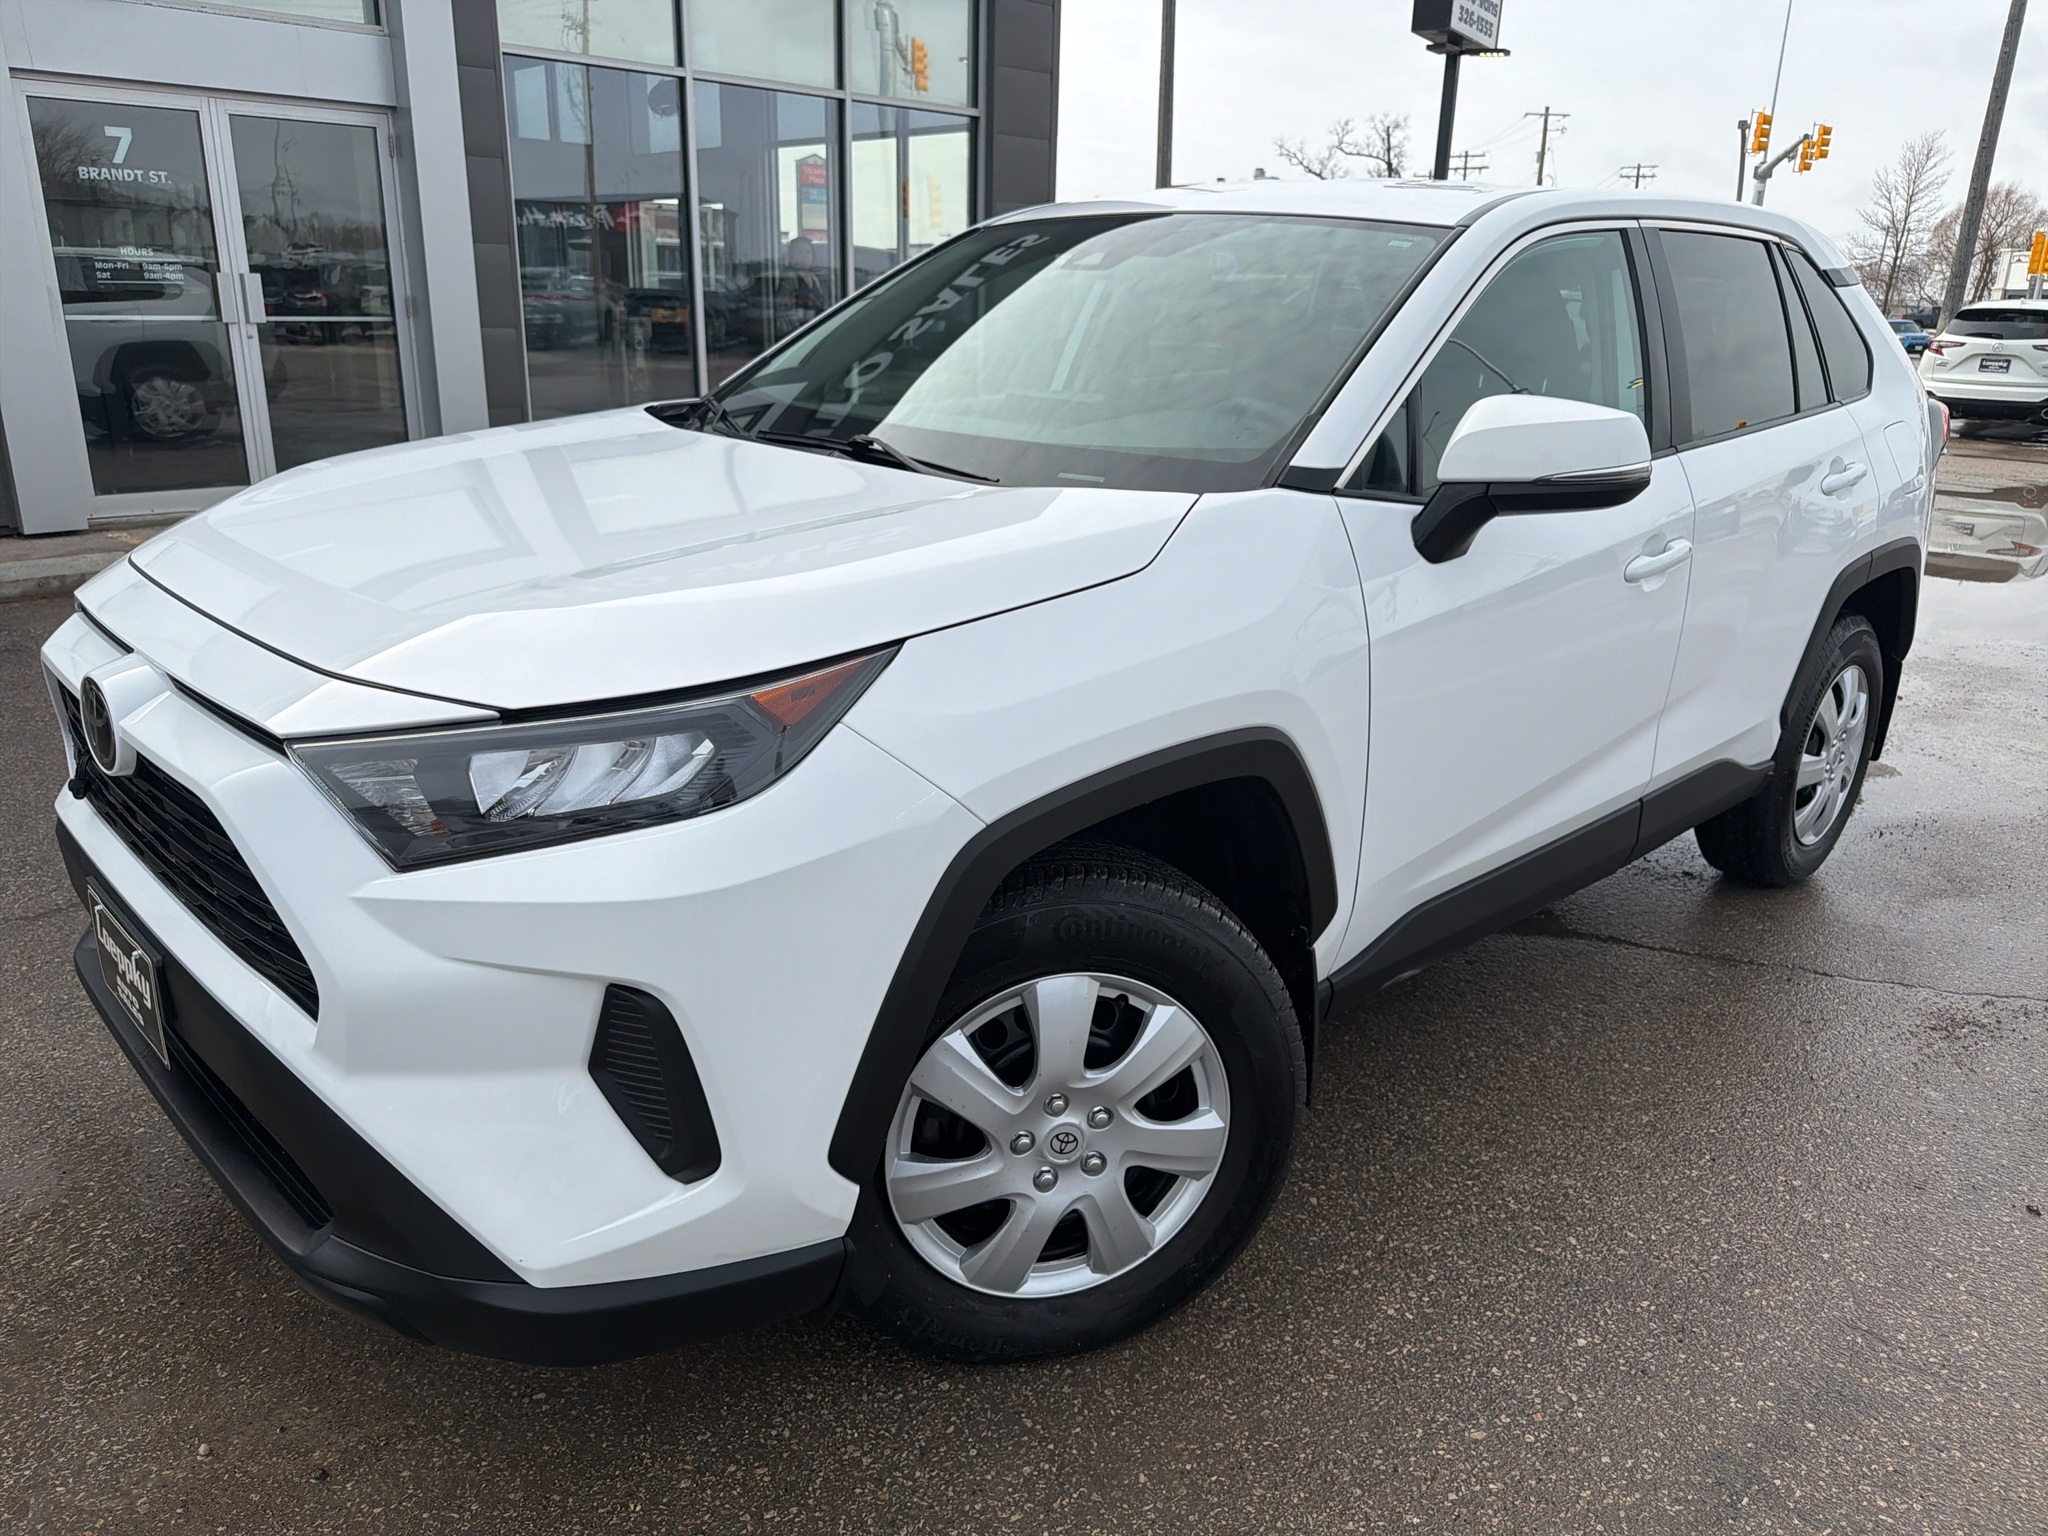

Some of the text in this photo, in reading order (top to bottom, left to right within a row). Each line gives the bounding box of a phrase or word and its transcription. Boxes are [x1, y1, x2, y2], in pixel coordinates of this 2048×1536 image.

[1458, 5, 1494, 39] 326-1555
[104, 126, 132, 164] 7
[78, 166, 172, 184] BRANDT ST.
[120, 247, 154, 256] HOURS
[95, 261, 130, 270] Mon-Fri
[96, 271, 111, 279] Sat
[94, 908, 152, 1011] Loeppky
